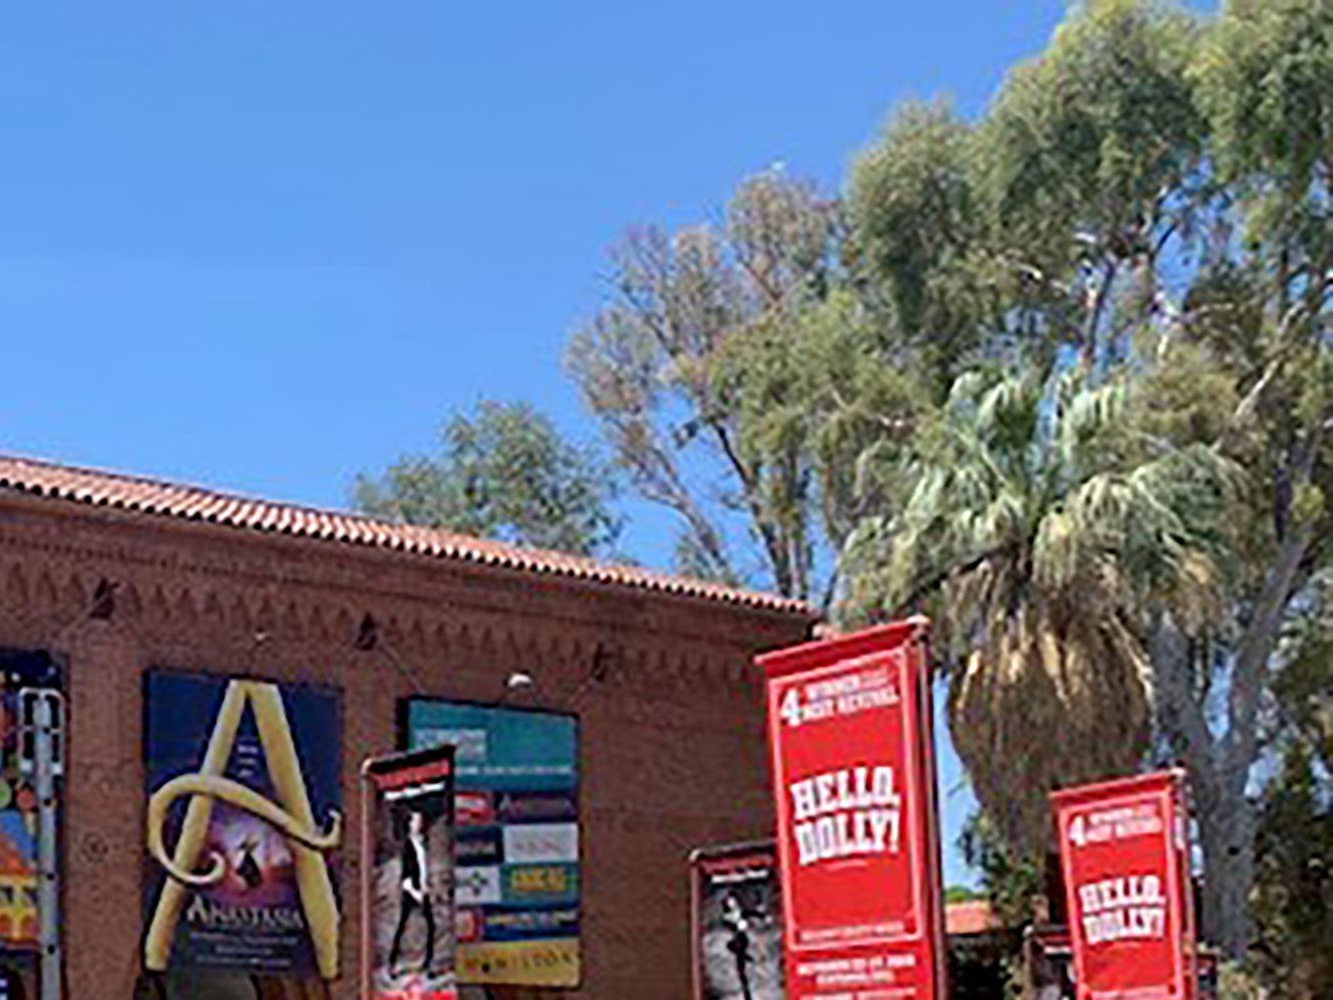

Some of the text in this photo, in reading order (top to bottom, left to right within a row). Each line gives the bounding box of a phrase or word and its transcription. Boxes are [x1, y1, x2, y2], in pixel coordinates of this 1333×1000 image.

[780, 689, 801, 726] 4
[790, 766, 900, 820] HELLO,
[794, 809, 900, 866] DOLLY!
[1078, 875, 1166, 913] HELLO,
[1083, 907, 1166, 946] DOLLY!
